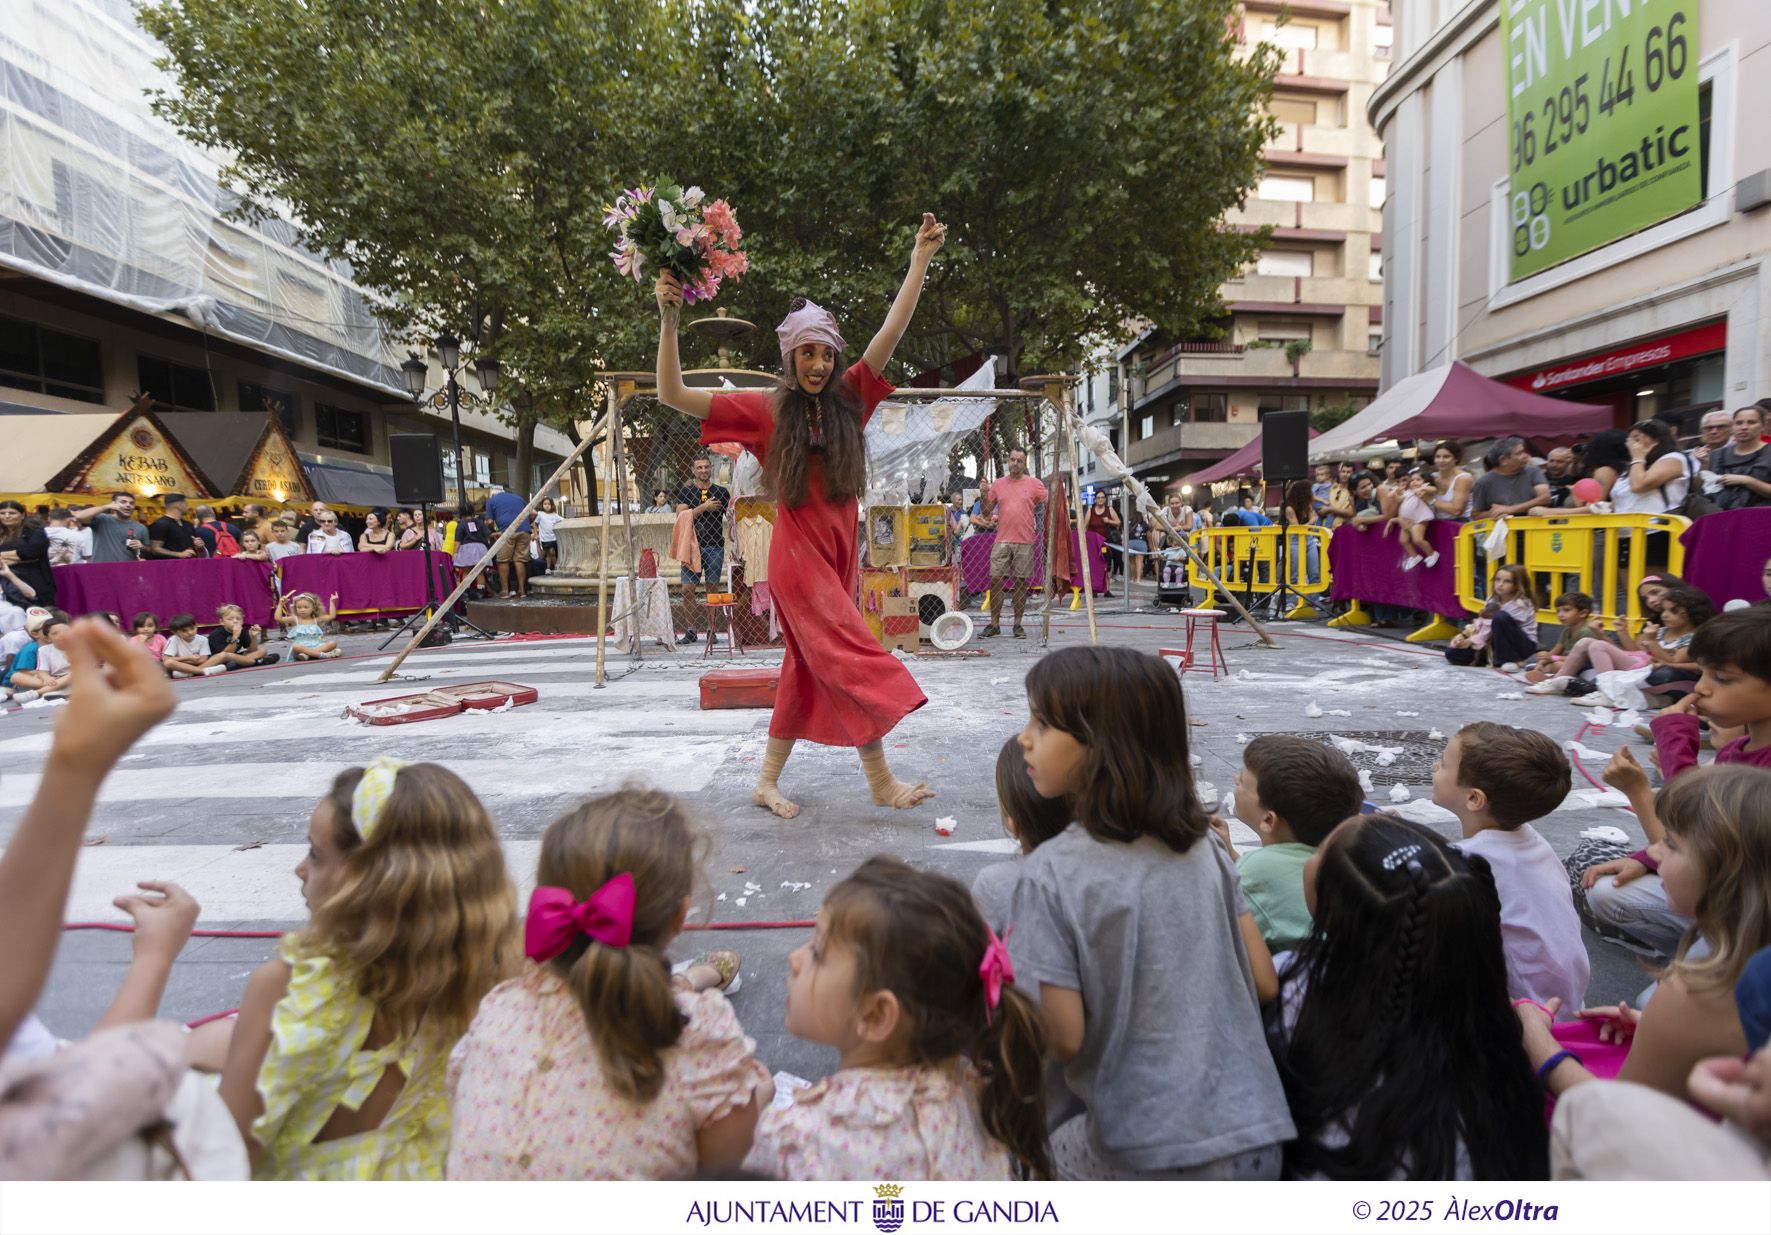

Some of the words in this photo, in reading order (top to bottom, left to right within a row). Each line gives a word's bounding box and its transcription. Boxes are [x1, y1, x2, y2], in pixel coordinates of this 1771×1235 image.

[1511, 3, 1548, 98] EN
[1543, 72, 1591, 156] 295
[1599, 44, 1636, 117] 44
[1645, 11, 1687, 92] 66
[1562, 125, 1691, 210] urbatic
[1545, 361, 1605, 385] Santander
[1604, 345, 1671, 371] Empresas
[119, 454, 168, 473] KEBAB
